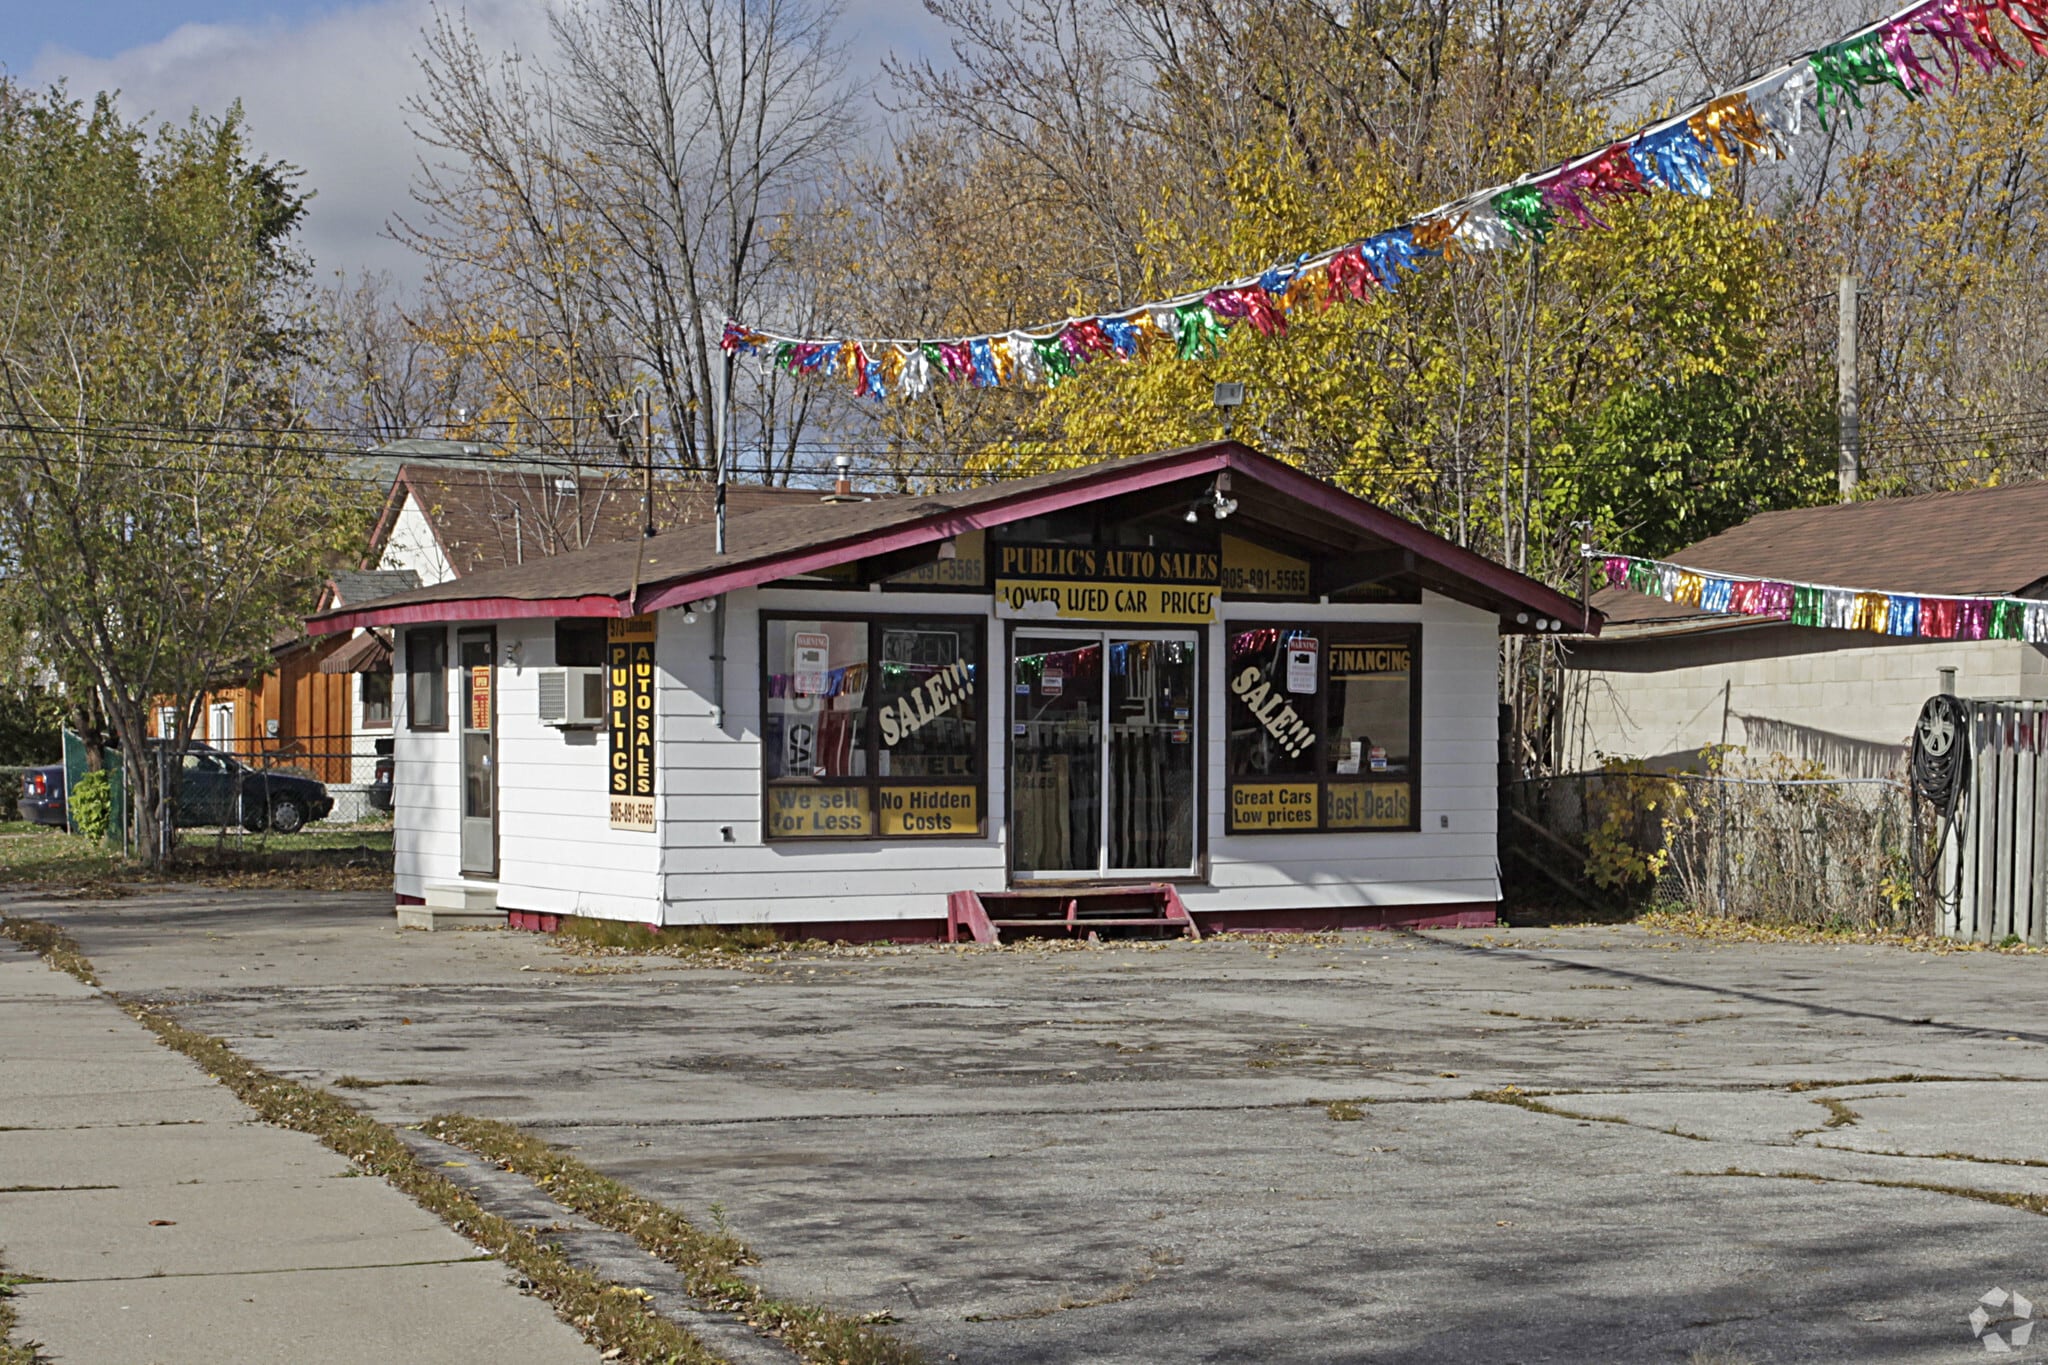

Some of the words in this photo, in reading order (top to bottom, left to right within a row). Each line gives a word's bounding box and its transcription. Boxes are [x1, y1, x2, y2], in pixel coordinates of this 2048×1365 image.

[1003, 546, 1096, 576] PUBLIC'S
[1103, 550, 1155, 578] AUTO
[1160, 552, 1218, 580] SALES
[1222, 567, 1306, 591] 905-891-5565
[1067, 587, 1109, 612] USED
[1115, 589, 1148, 613] CAR
[1161, 591, 1214, 615] PRICES
[1328, 650, 1411, 671] FINANCING
[879, 657, 974, 746] SALE!!!
[1231, 666, 1316, 759] SALE!!!
[612, 647, 627, 791] PUBLICS
[776, 790, 811, 810] We
[819, 788, 859, 809] sell
[881, 791, 904, 810] No
[910, 790, 971, 810] Hidden
[1234, 789, 1274, 806] Great
[1279, 788, 1312, 805] Cars
[1327, 790, 1360, 821] Best
[1364, 788, 1409, 820] Deals
[610, 801, 653, 825] 905-891-5565
[774, 812, 804, 831] for
[813, 811, 862, 831] Less
[903, 811, 952, 831] Costs
[1234, 808, 1263, 824] Low
[1268, 807, 1312, 827] prices
